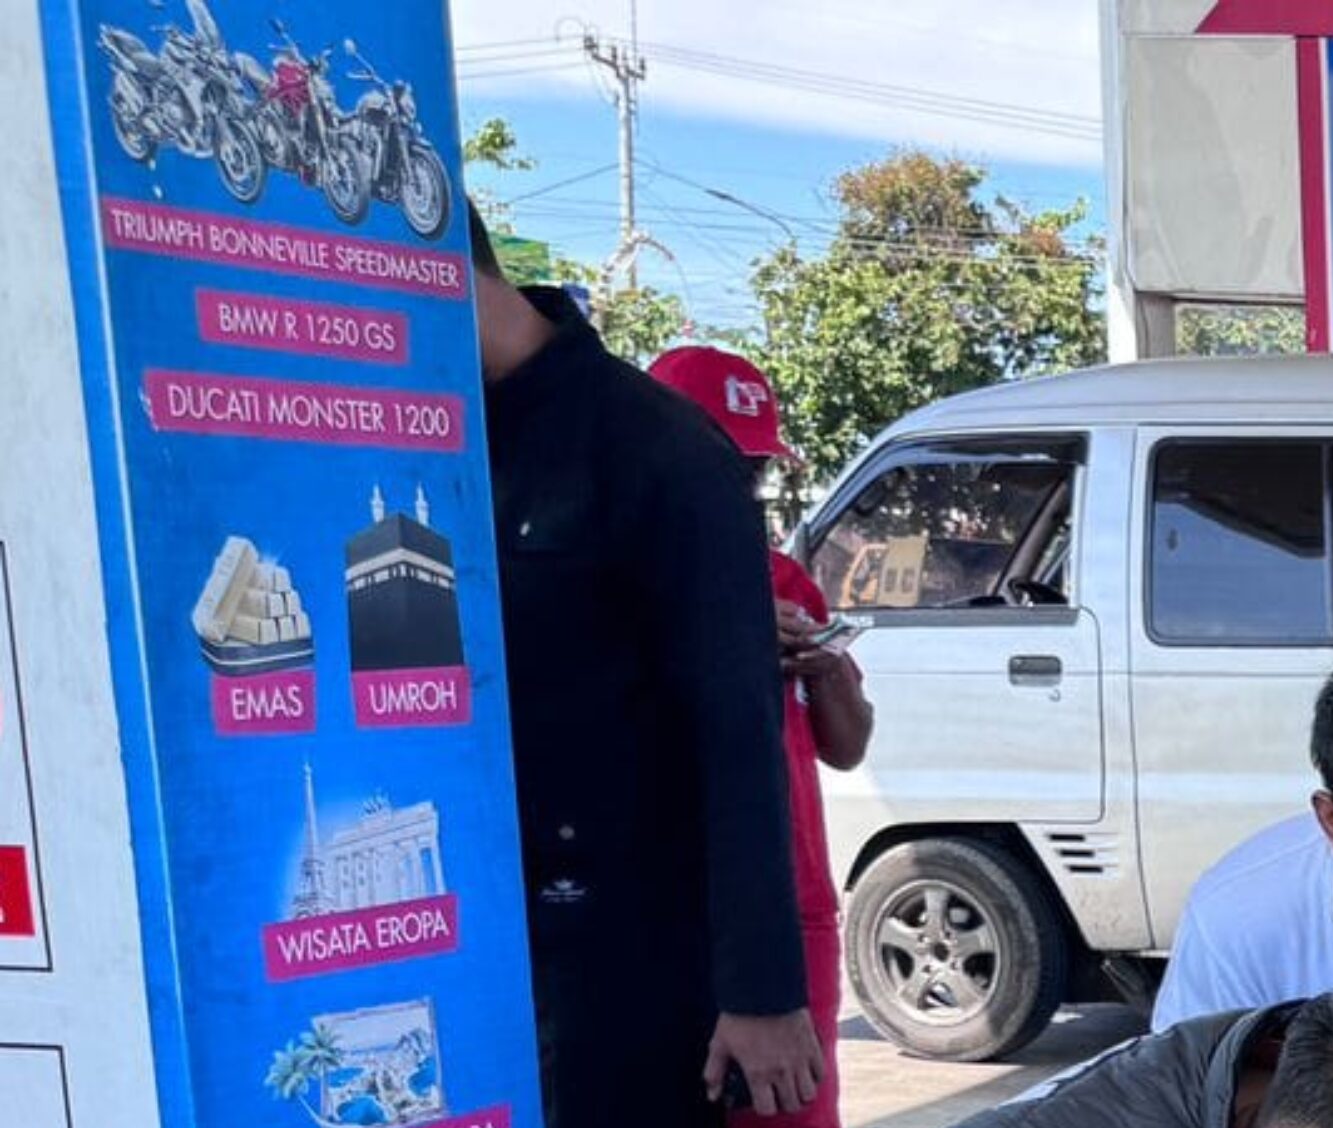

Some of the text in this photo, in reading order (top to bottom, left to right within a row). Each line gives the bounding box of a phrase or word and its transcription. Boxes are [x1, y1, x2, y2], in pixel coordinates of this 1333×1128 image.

[111, 209, 460, 289] TRIUMPH BONNEVILLE SPEEDMASTER
[219, 304, 395, 351] BMW R 1250 GS
[168, 384, 450, 438] DUCATI MONSTER 1200
[232, 687, 303, 721] EMAS
[369, 681, 457, 714] UMROH
[278, 910, 449, 964] WISATA EROPA
